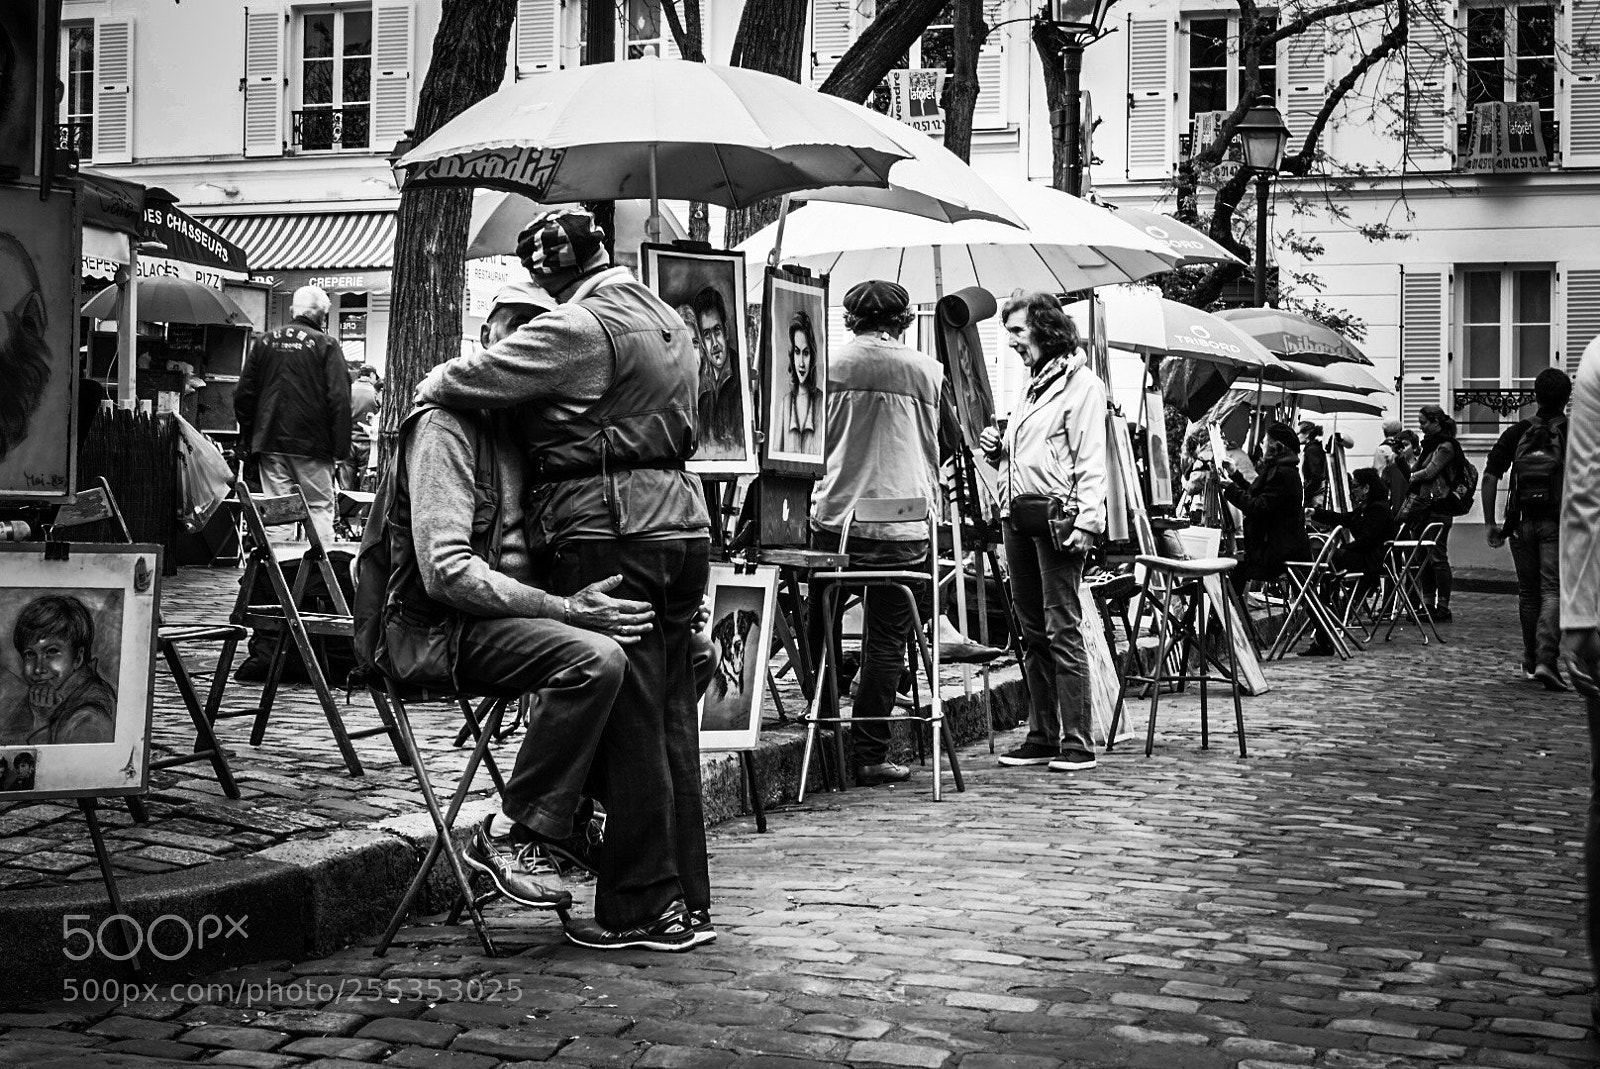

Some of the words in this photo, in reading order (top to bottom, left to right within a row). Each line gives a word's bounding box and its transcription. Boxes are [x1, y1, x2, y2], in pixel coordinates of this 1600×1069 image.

[167, 213, 229, 262] CHASSEURS
[308, 276, 364, 287] CREPERIE
[475, 268, 509, 282] RESTAURANT
[1174, 335, 1241, 353] TRIBORD
